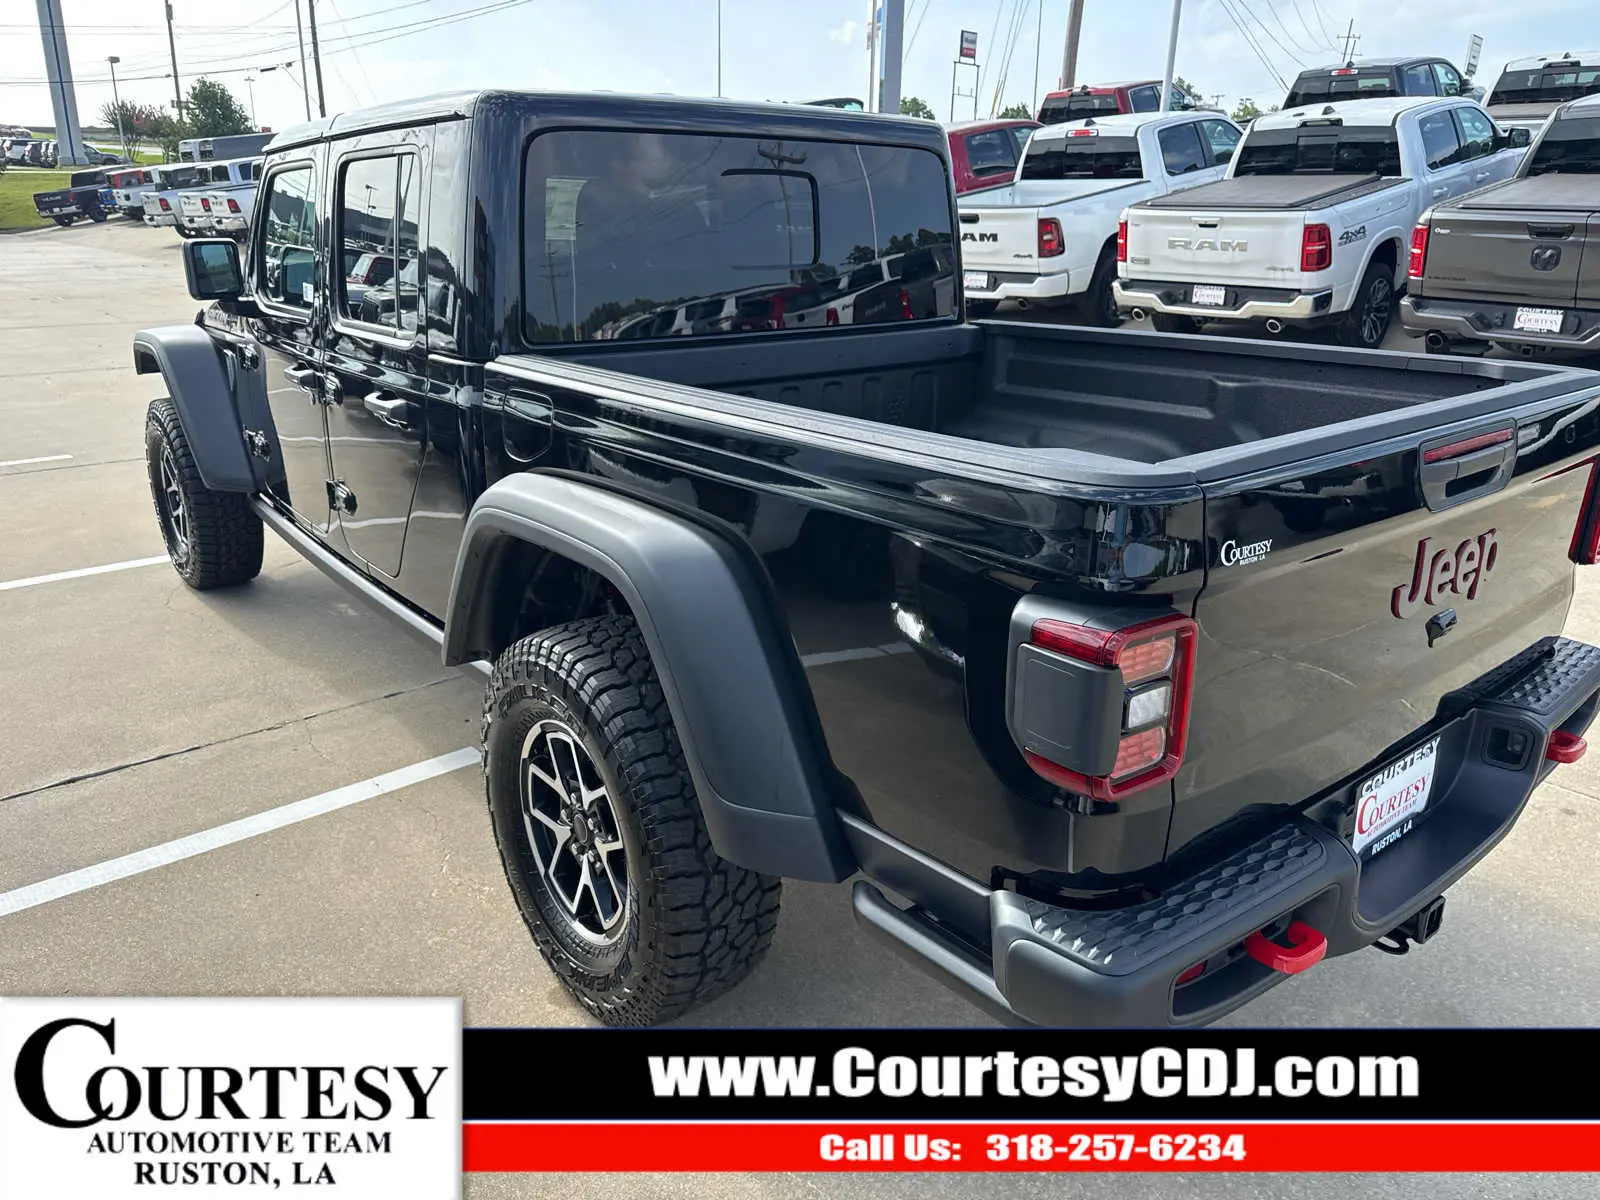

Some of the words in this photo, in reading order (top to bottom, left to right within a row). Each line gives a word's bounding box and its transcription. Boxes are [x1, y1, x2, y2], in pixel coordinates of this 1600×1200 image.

[961, 233, 998, 242] AM
[1167, 237, 1248, 252] RAM
[1220, 539, 1272, 567] COURTESY
[1391, 528, 1498, 619] Jeep
[1361, 737, 1440, 800] COURTESY
[1358, 775, 1429, 835] COURTESY
[1403, 819, 1412, 834] LA
